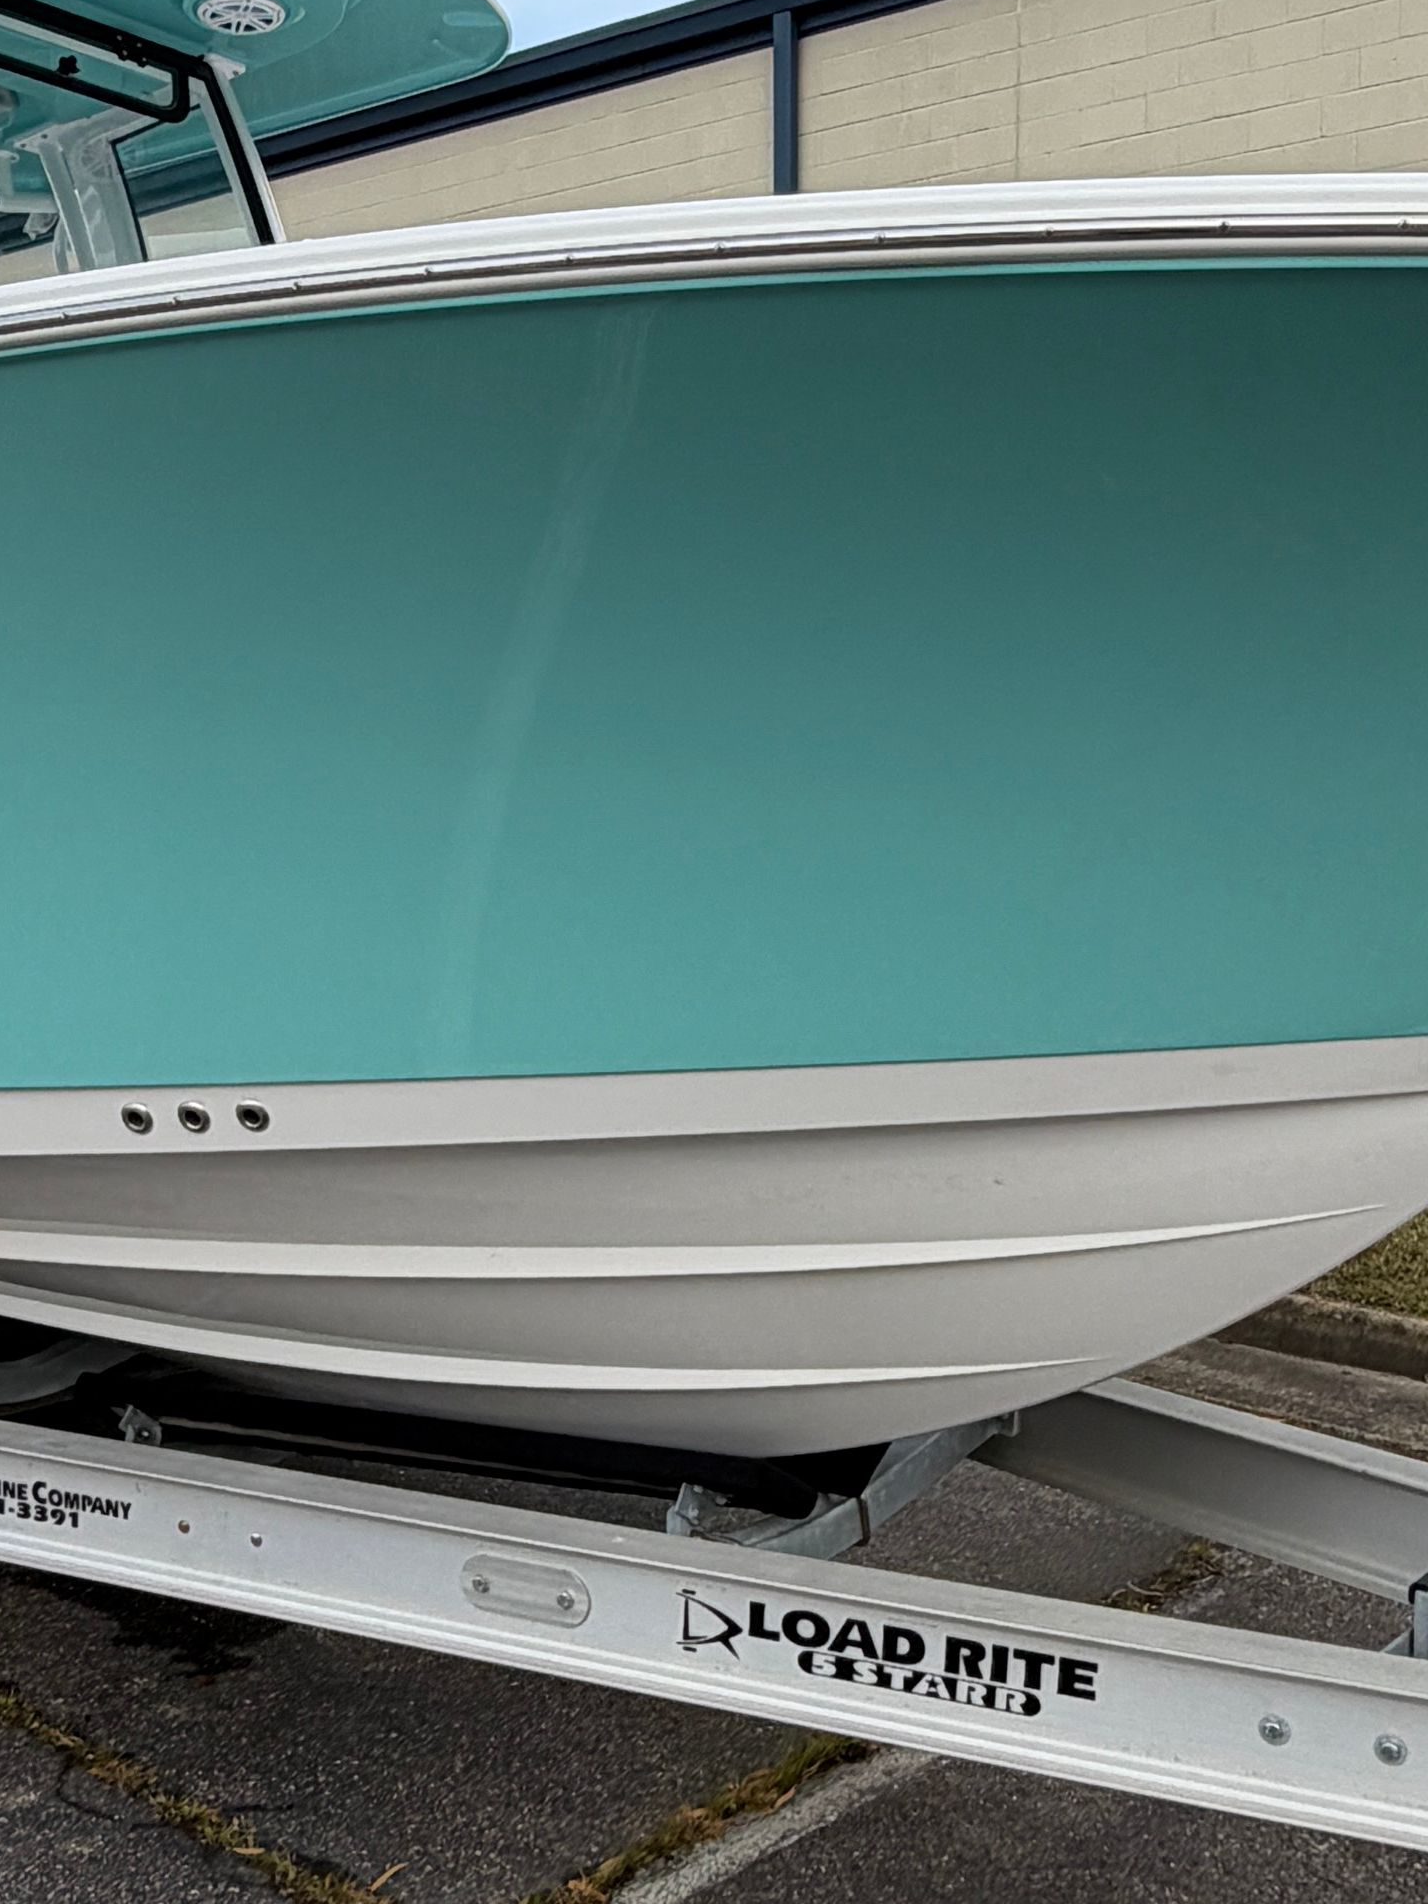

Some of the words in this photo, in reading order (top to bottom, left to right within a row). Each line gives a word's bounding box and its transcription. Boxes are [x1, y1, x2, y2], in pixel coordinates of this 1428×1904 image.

[32, 1481, 132, 1520] COMPANY
[748, 1601, 926, 1666] LOAD
[944, 1636, 1099, 1701] RITE
[810, 1654, 837, 1678] 5
[852, 1662, 1027, 1715] STARR
